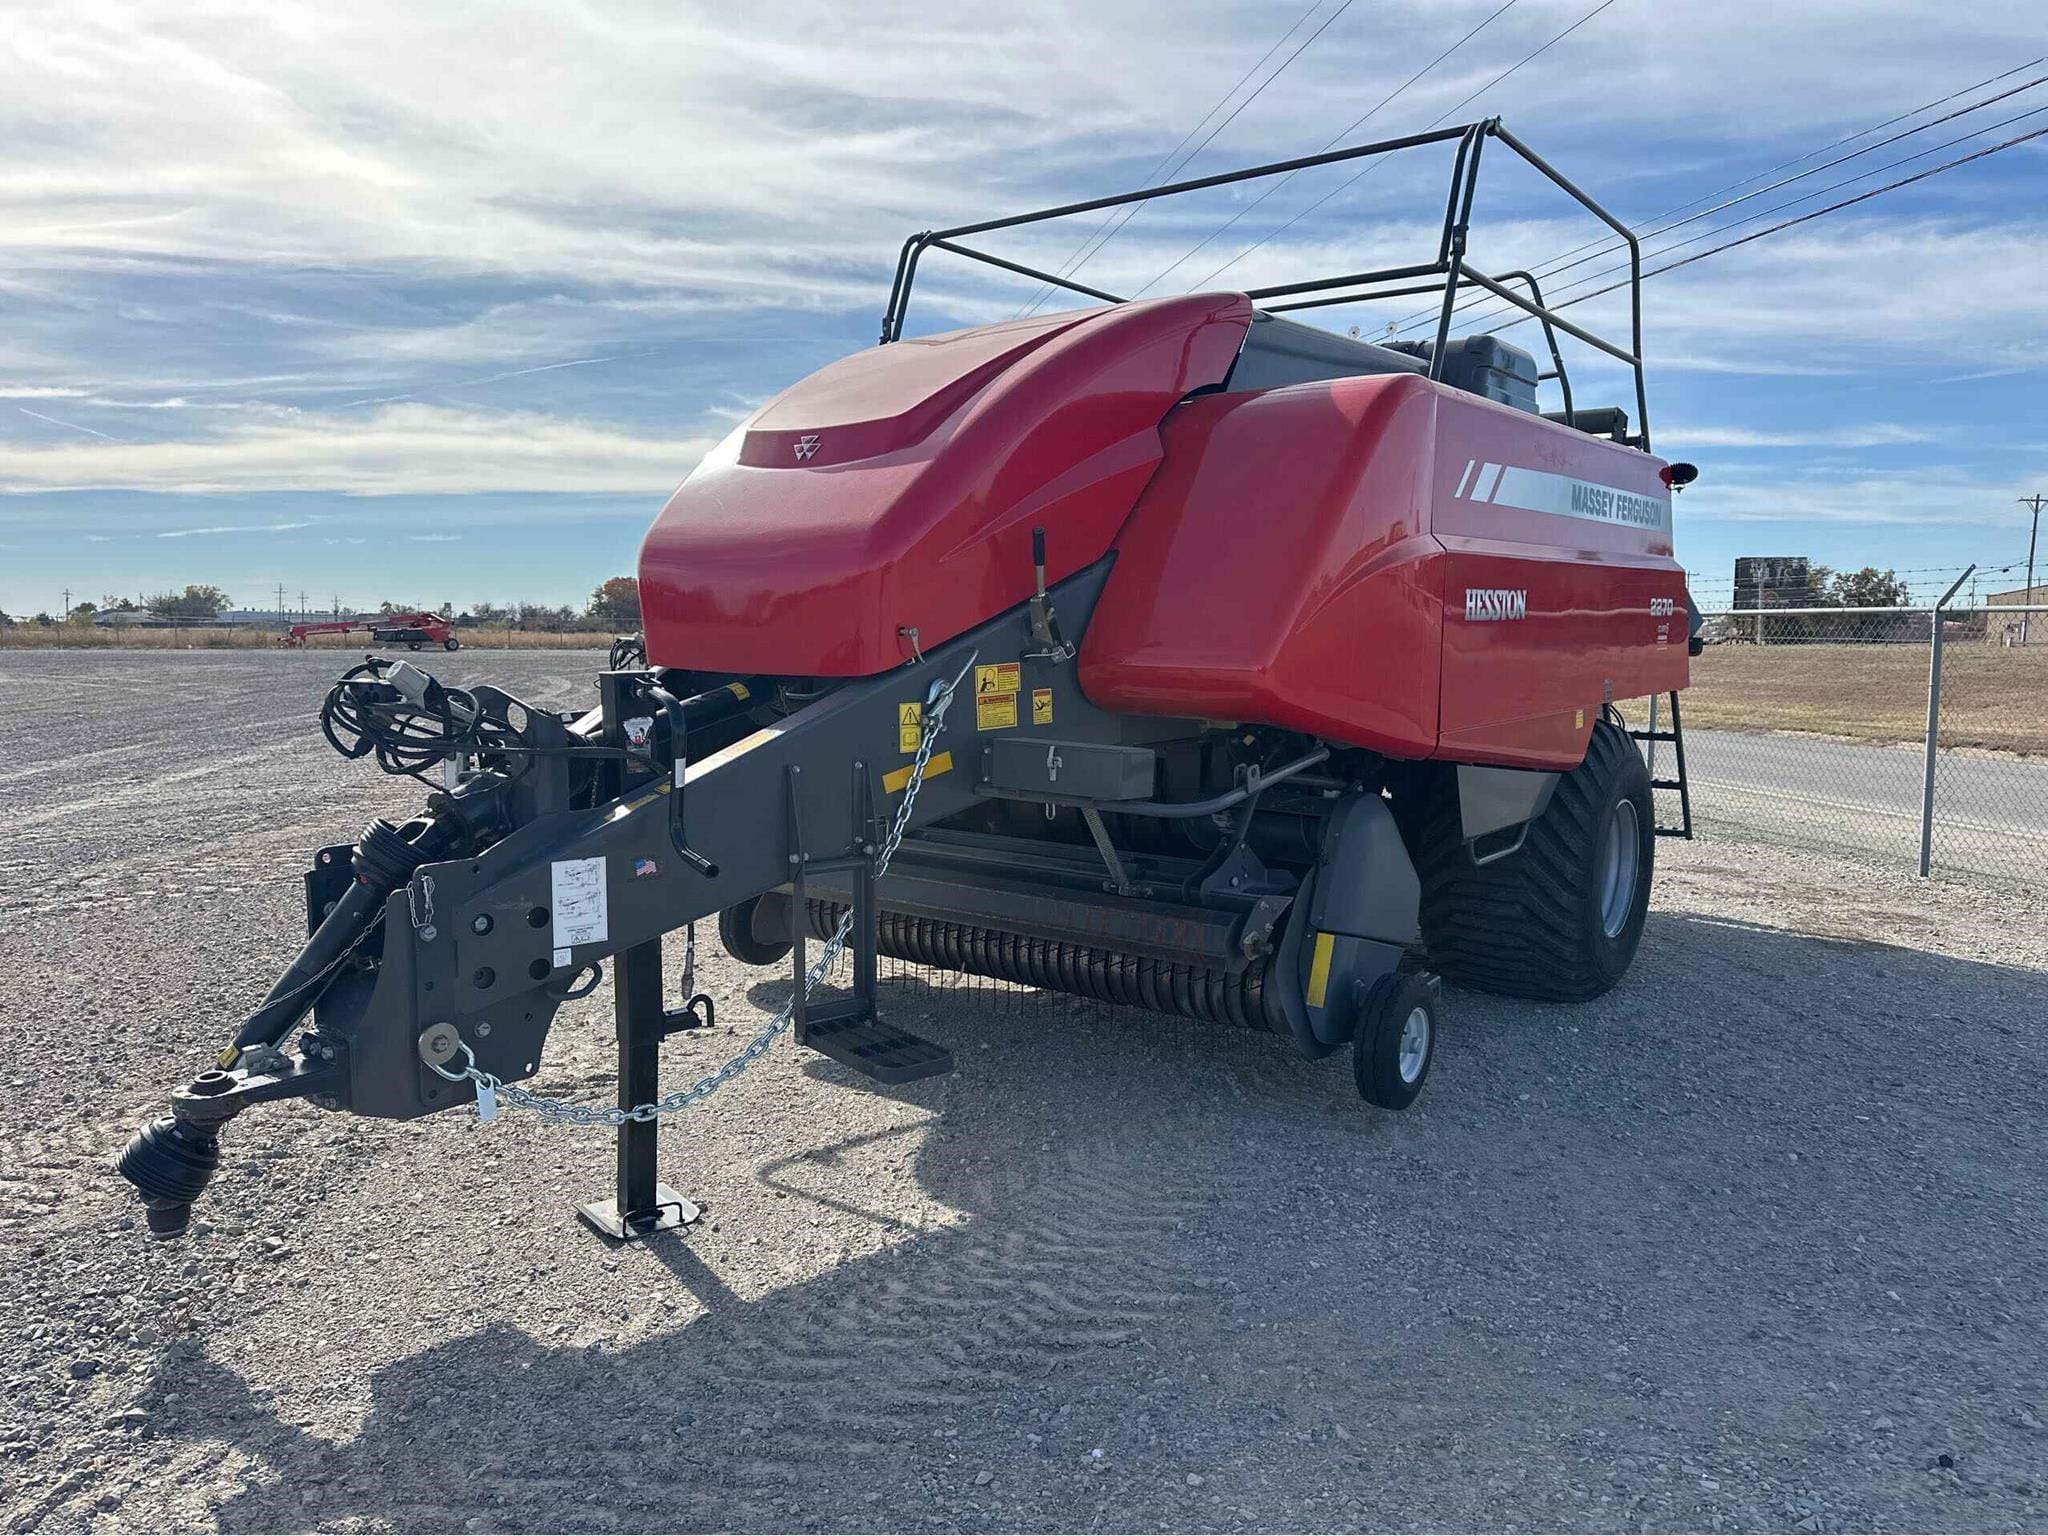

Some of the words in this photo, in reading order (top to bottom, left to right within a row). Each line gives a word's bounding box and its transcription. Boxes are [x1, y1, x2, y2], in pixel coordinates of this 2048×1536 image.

[1571, 484, 1614, 518] MASSEY
[1616, 494, 1662, 527] FERGUSON
[1465, 589, 1527, 621] HESSTON
[1650, 598, 1673, 616] 2270
